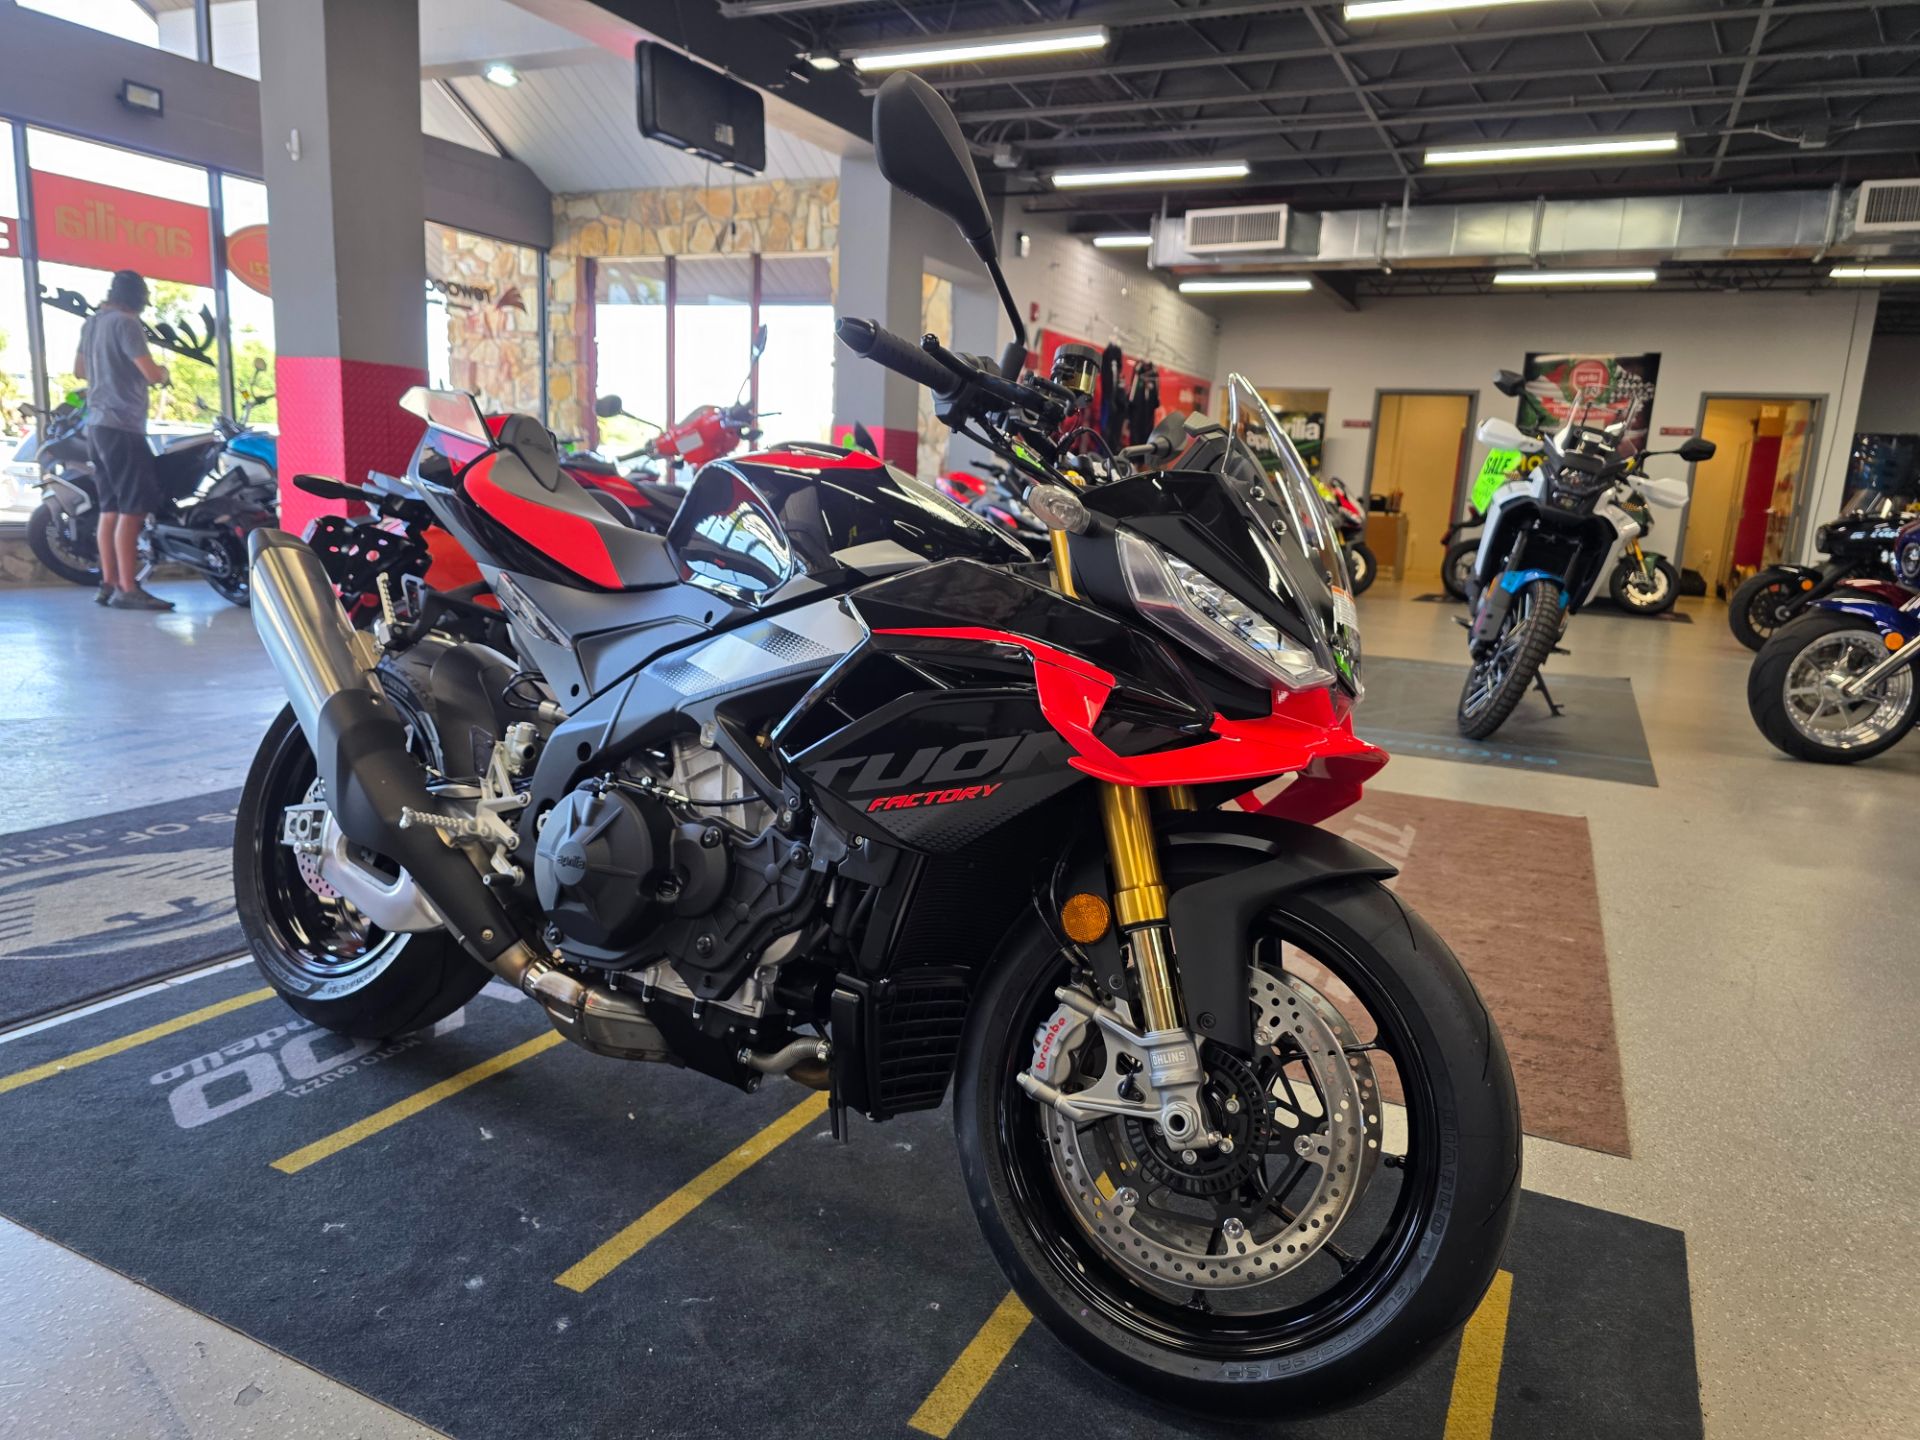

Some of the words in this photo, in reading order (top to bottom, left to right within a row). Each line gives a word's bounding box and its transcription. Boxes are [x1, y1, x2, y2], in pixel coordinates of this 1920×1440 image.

[1483, 456, 1512, 475] SALE
[865, 781, 1004, 814] FACTORY
[118, 822, 191, 844] OF
[360, 1037, 422, 1067] MOTO
[1035, 1016, 1067, 1073] brembo
[284, 1064, 359, 1098] GUZZI
